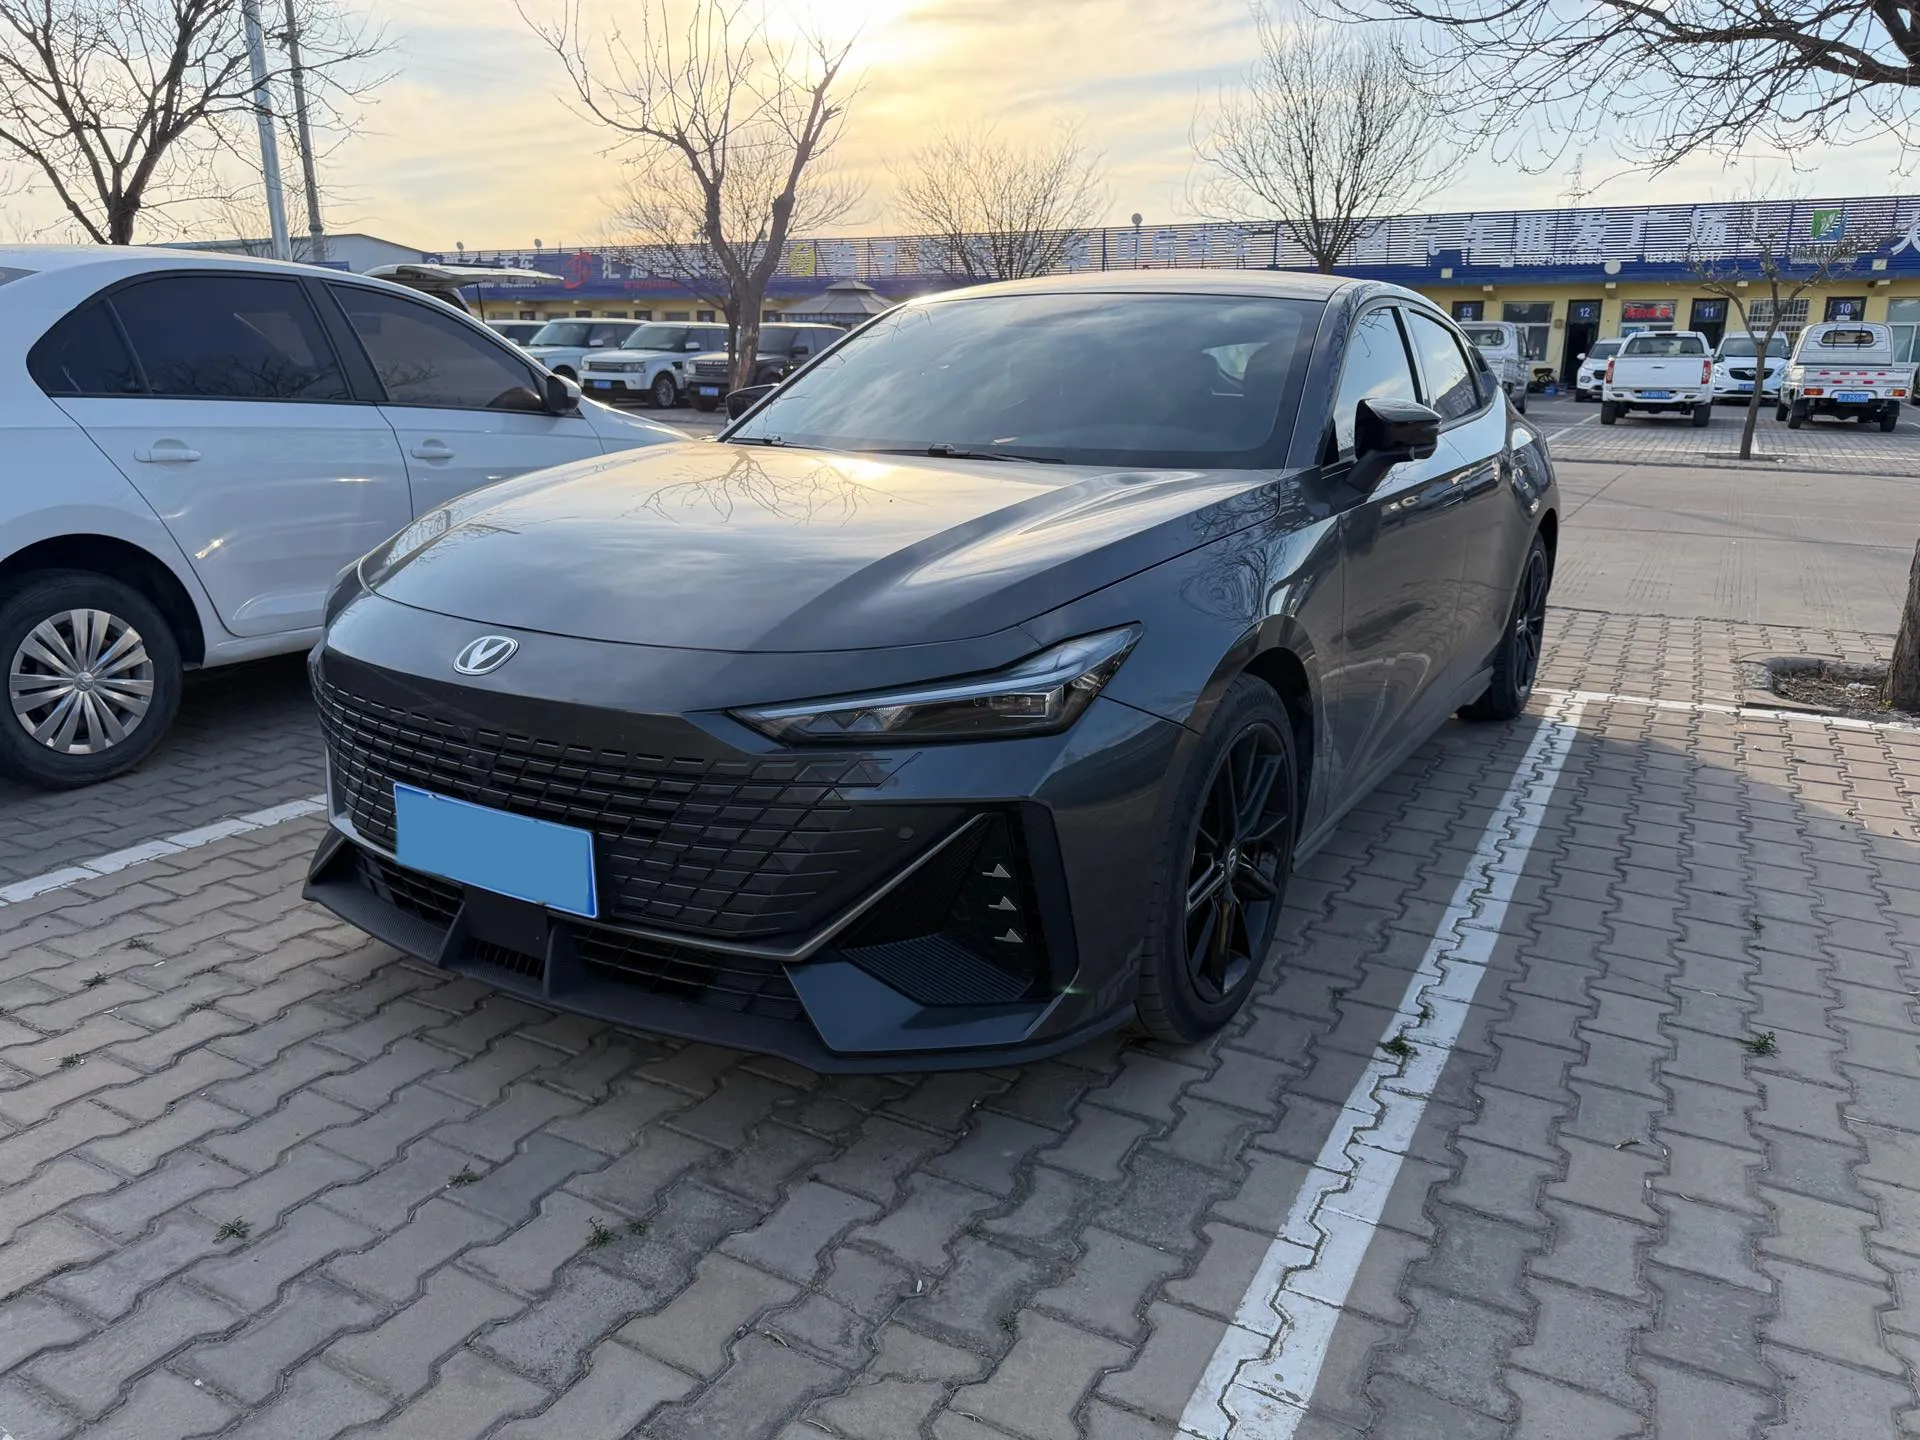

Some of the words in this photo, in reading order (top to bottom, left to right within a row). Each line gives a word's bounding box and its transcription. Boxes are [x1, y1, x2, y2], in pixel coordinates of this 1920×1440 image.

[1579, 306, 1591, 318] 12
[1704, 306, 1715, 318] 11
[1839, 302, 1852, 315] 10
